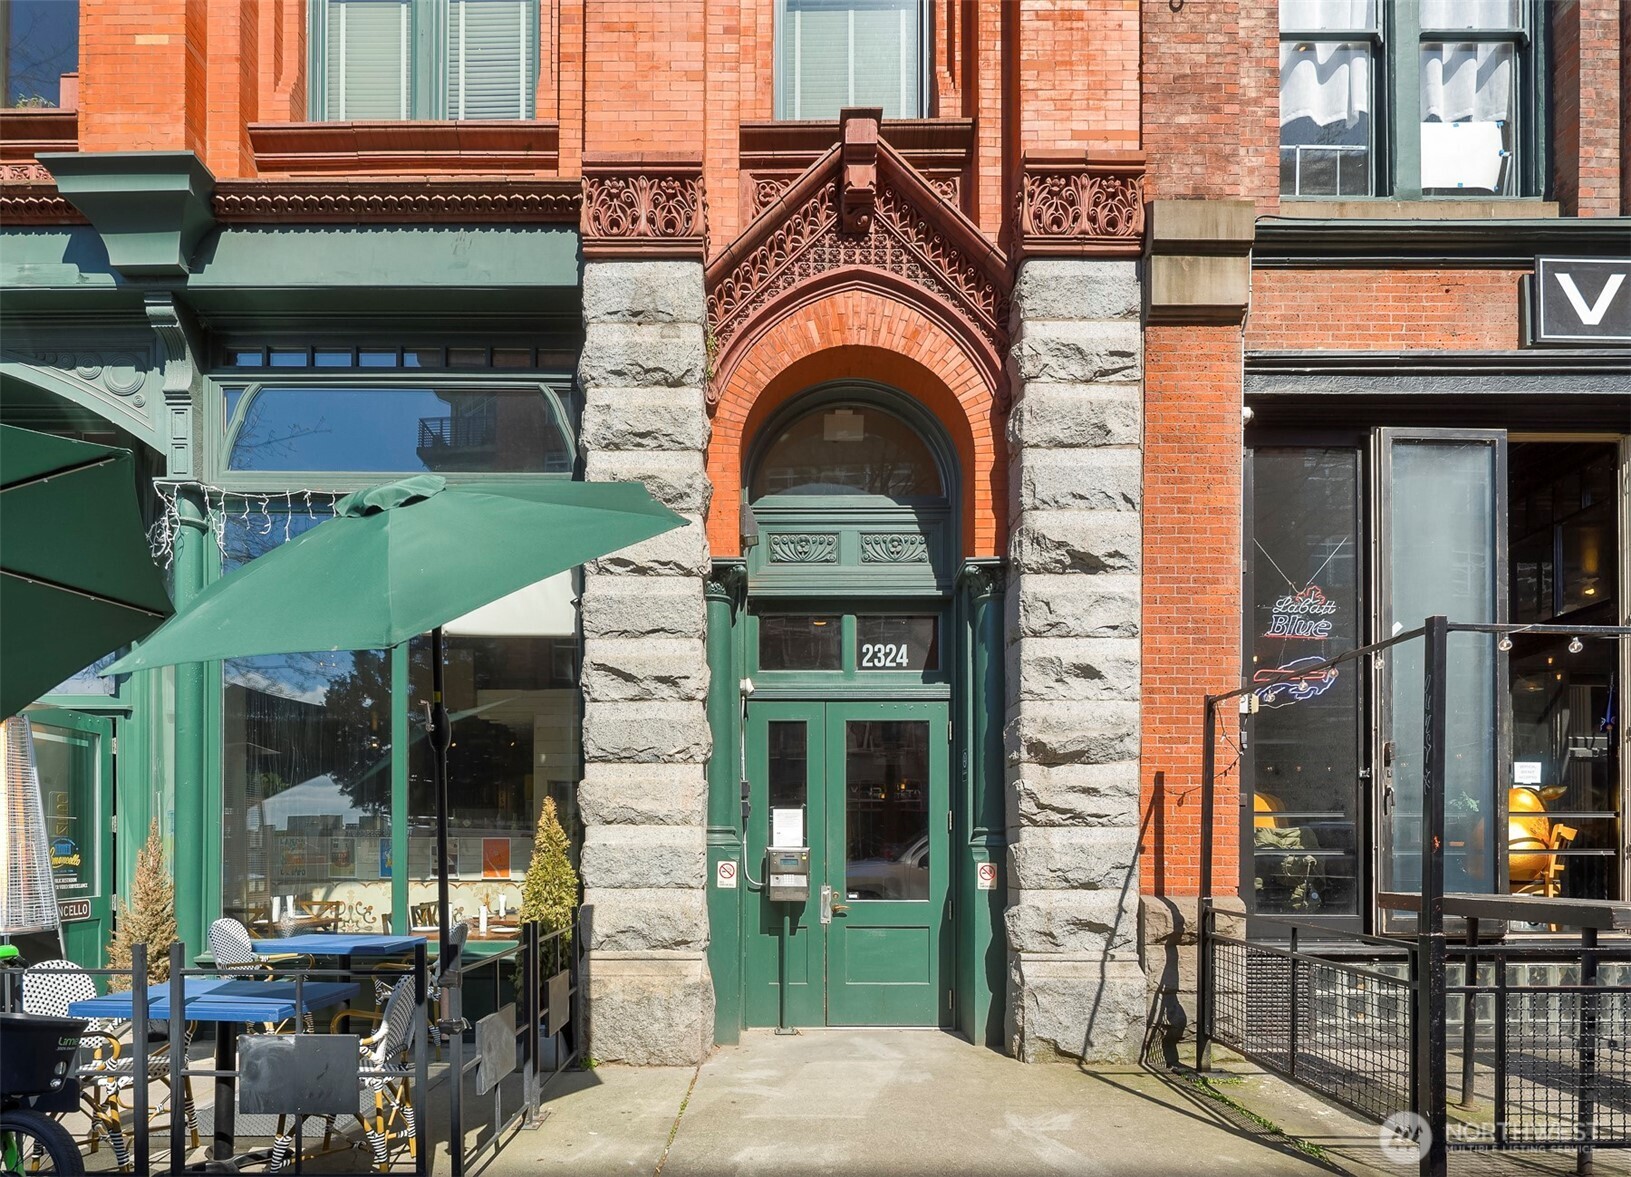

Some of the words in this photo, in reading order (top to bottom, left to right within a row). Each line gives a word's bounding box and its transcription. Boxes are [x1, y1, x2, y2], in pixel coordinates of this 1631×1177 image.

[1272, 595, 1336, 614] Labatt
[1269, 614, 1332, 637] Blue
[862, 643, 909, 667] 2324
[59, 903, 88, 917] NCELLO
